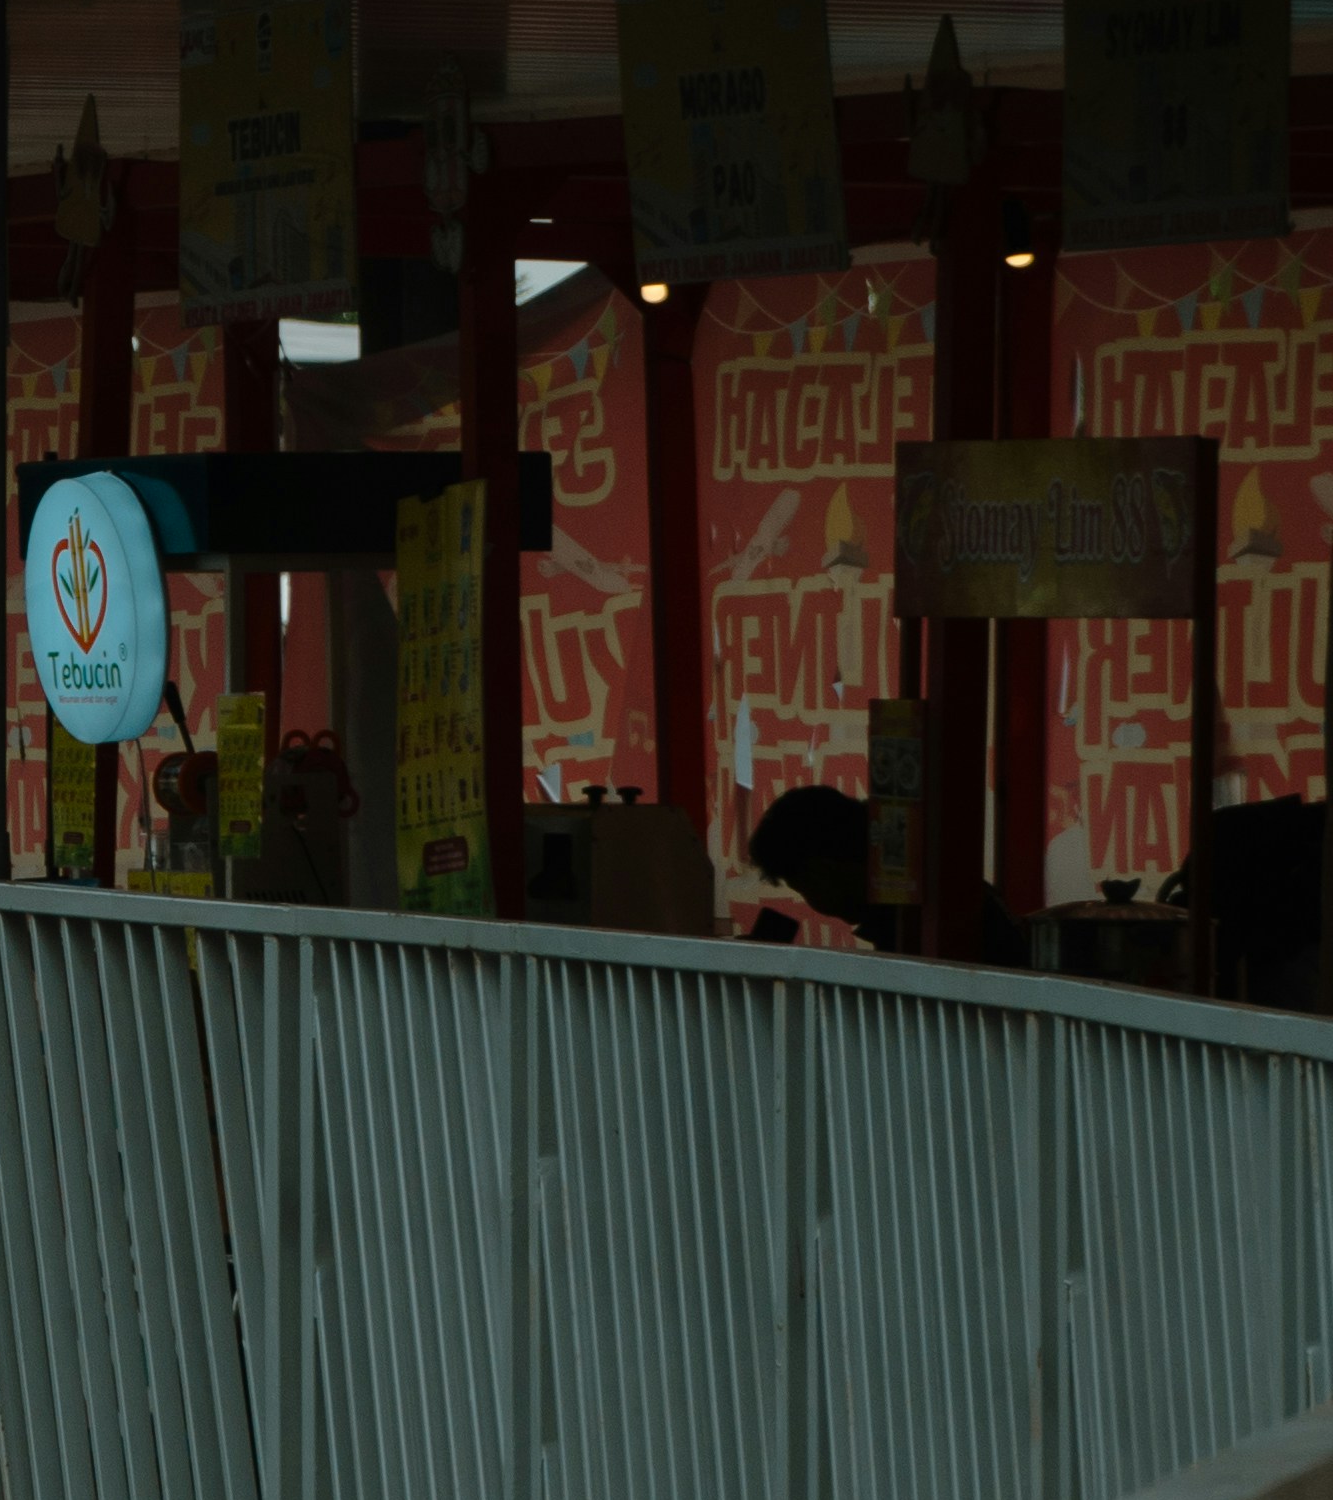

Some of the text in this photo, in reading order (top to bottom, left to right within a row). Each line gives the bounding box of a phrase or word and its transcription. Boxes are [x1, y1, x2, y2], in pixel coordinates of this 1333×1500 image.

[679, 66, 765, 120] MORAGO
[228, 110, 302, 162] TEBUCIN
[938, 472, 1146, 584] Siomay Lim 88
[47, 650, 122, 690] Tebucin
